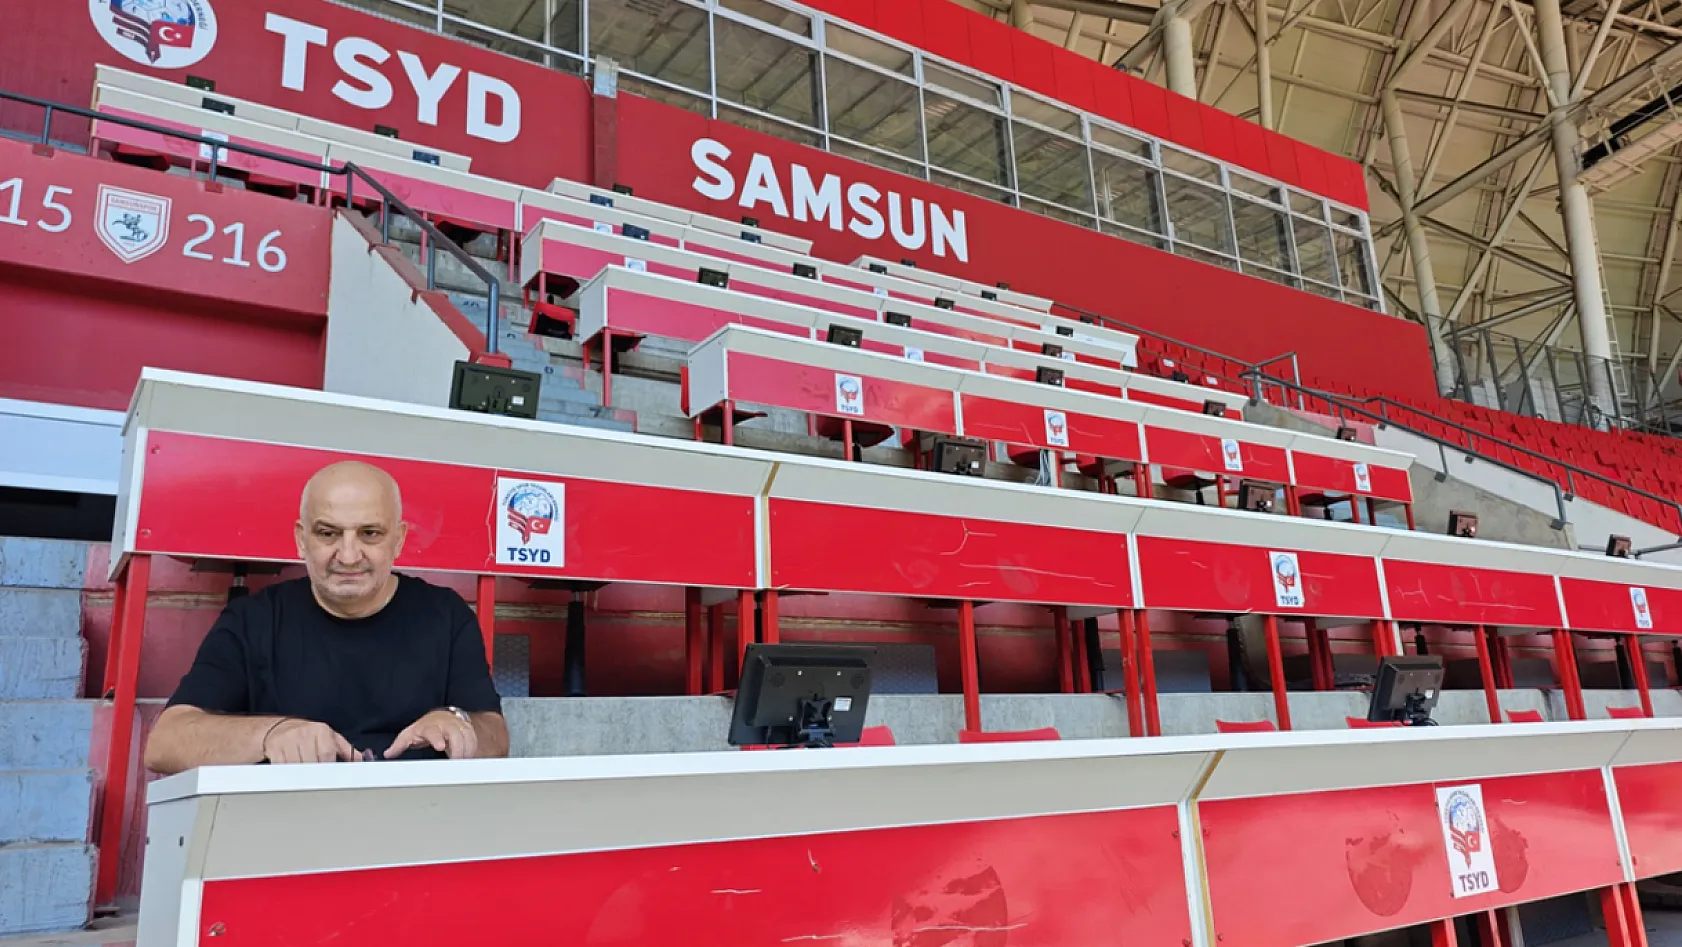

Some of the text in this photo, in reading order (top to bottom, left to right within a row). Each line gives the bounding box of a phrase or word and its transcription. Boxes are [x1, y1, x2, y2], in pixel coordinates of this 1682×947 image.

[265, 12, 521, 143] TSYD
[0, 178, 73, 232] 15
[691, 138, 968, 262] SAMSUN
[183, 214, 287, 273] 216
[507, 548, 551, 563] TSYD
[1459, 871, 1490, 893] TSYD
